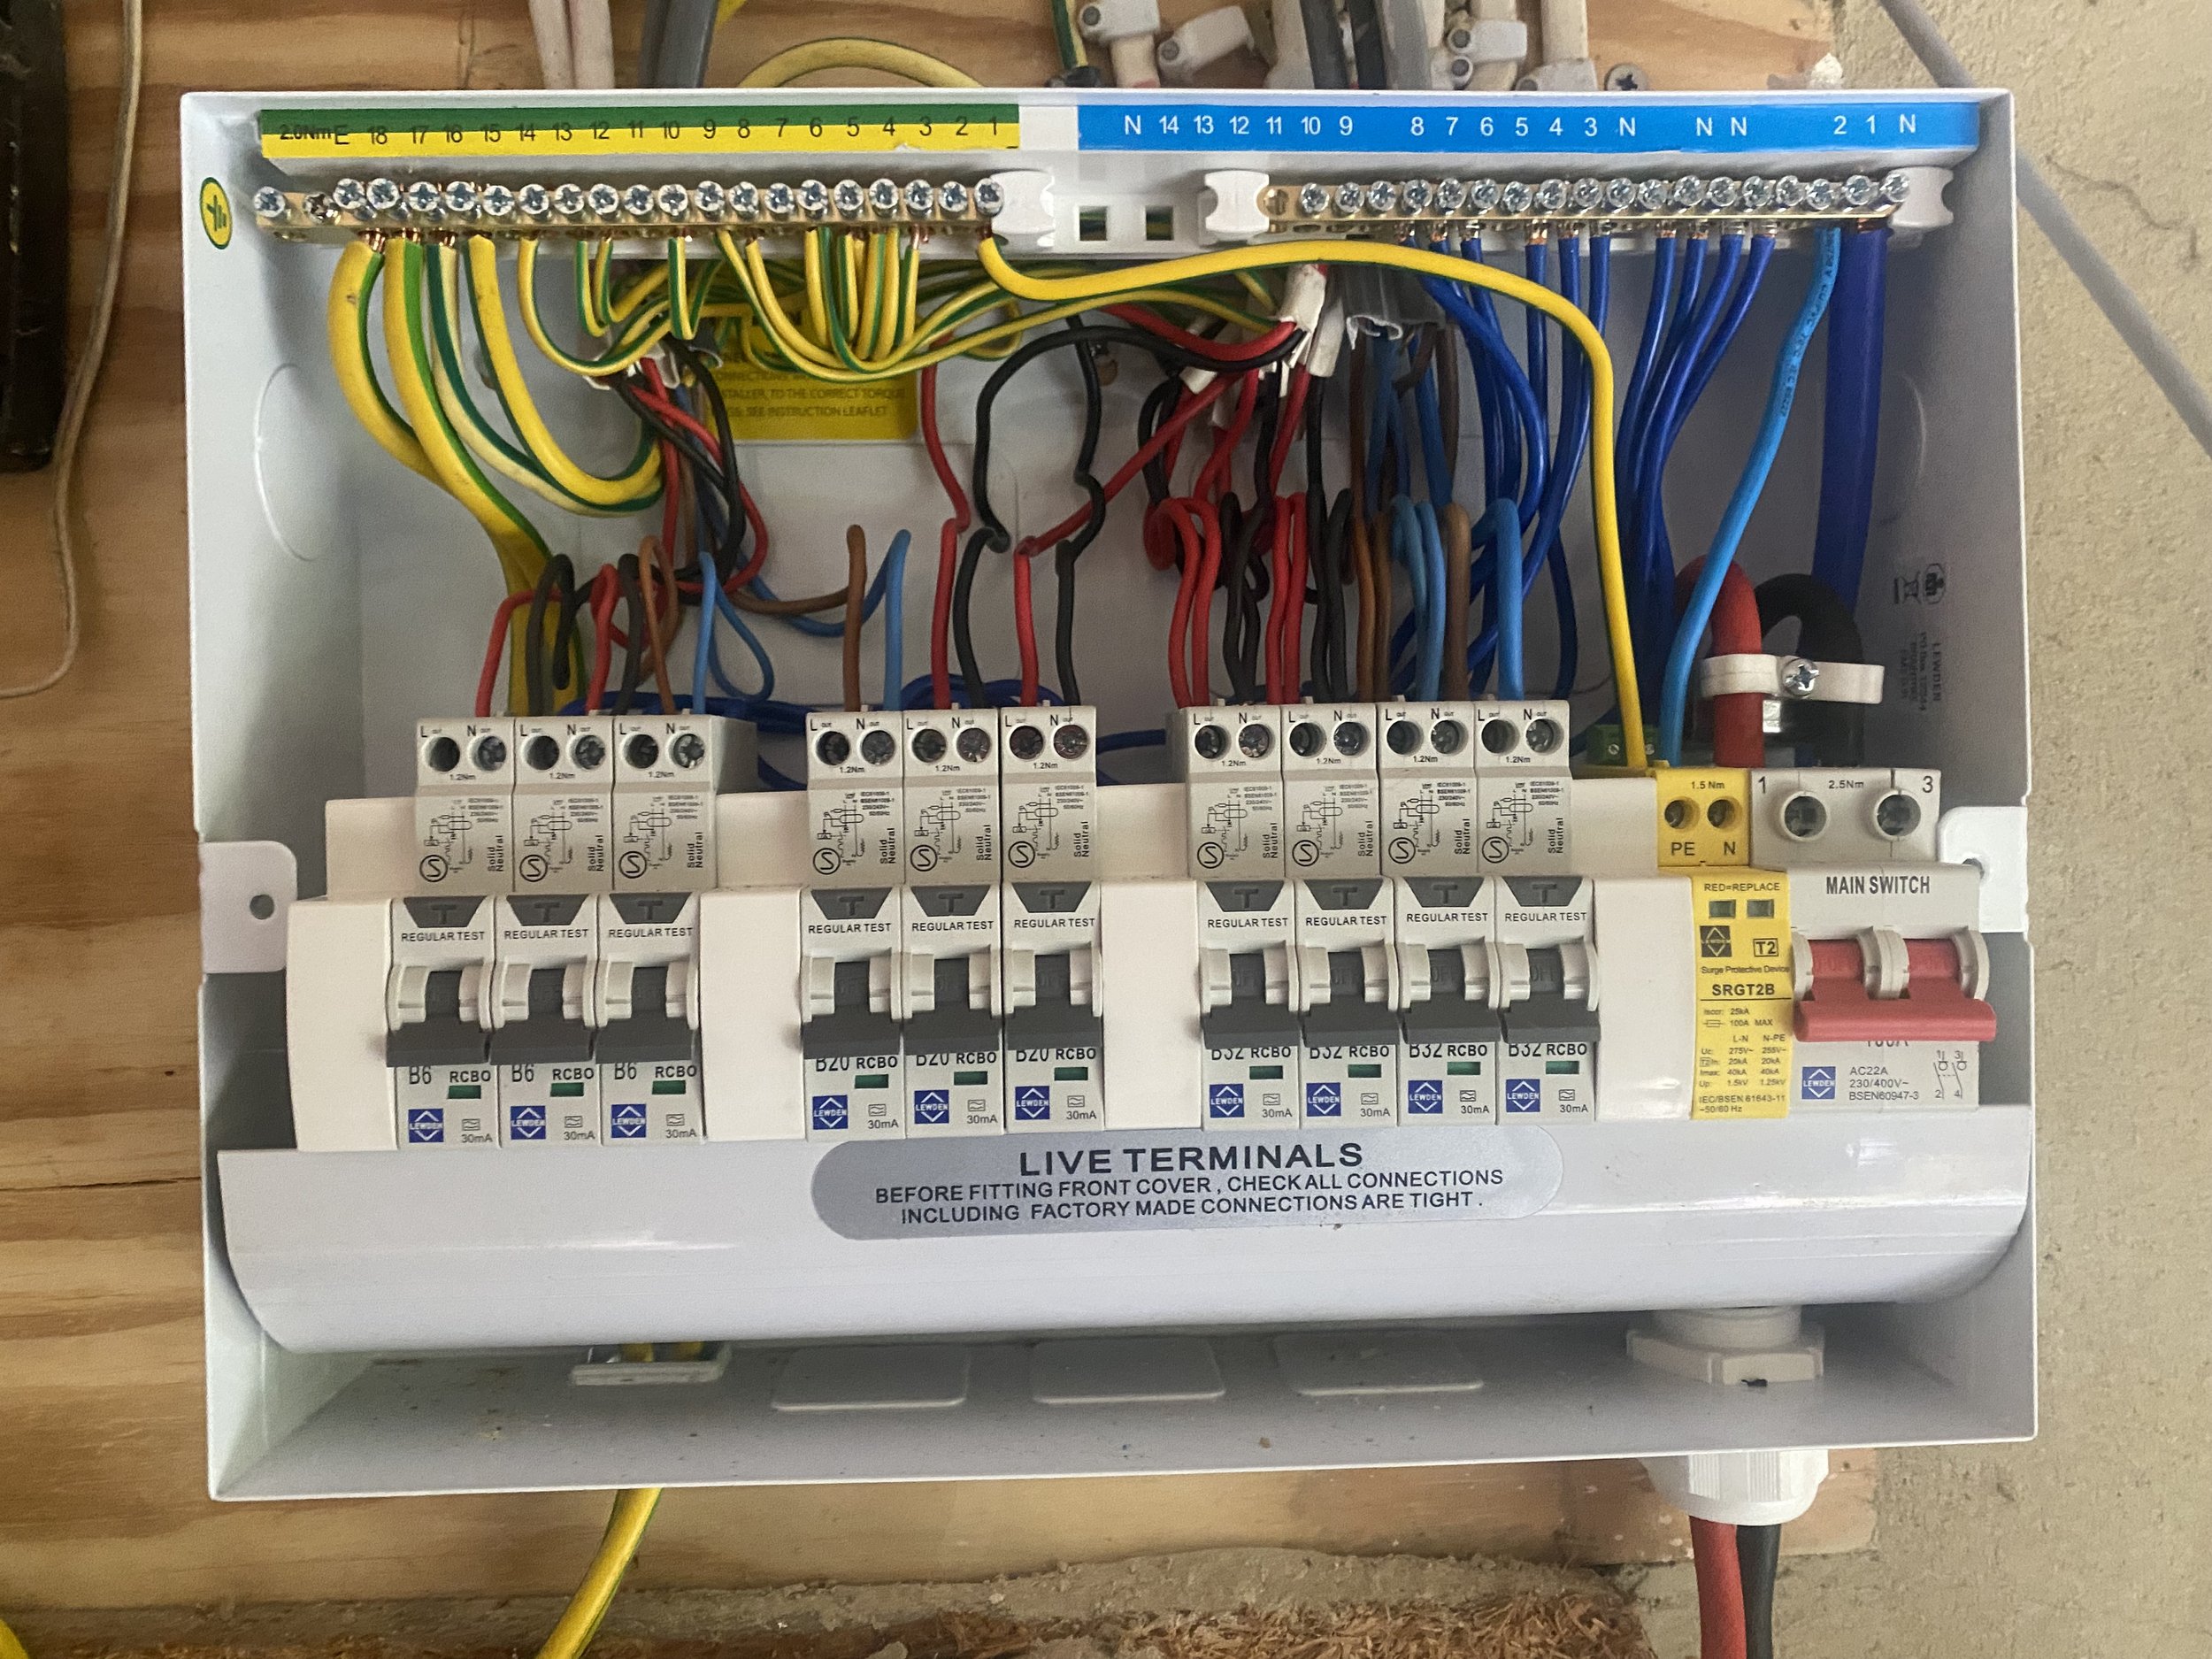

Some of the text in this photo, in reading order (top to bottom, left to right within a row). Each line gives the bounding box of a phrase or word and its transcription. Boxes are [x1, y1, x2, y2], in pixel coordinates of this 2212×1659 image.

[334, 126, 350, 144] E
[369, 126, 388, 145] 18
[411, 126, 427, 144] 17
[446, 126, 463, 143] 16
[484, 125, 501, 142] 15
[519, 124, 536, 142] 14
[555, 124, 572, 142] 13
[592, 122, 611, 140] 12
[629, 120, 643, 138] 11
[663, 121, 680, 140] 10
[703, 120, 716, 140] 9
[738, 120, 750, 139] 8
[775, 119, 787, 136] 7
[810, 119, 823, 137] 6
[848, 119, 859, 136] 5
[882, 118, 895, 135] 4
[919, 118, 932, 136] 3
[956, 118, 968, 135] 2
[990, 117, 996, 135] 1
[1125, 114, 1916, 137] N 14 13 12 11 10 9 8 7 6 5 4 3 N N N 2 1 N
[1386, 709, 1392, 720] L
[1431, 708, 1440, 719] N
[810, 720, 818, 731] L
[856, 718, 865, 729] N
[1692, 780, 1724, 789] 1.5 Nm
[1758, 777, 1766, 794] 1
[1829, 780, 1864, 789] 2.5Nm
[1923, 776, 1933, 793] 3
[1671, 842, 1695, 856] PE
[1724, 841, 1736, 856] N
[1704, 882, 1780, 892] RED=REPLACE
[1826, 876, 1930, 894] MAIN SWITCH
[1306, 915, 1387, 926] REGULAR TEST
[1406, 912, 1487, 923] REGULAR TEST
[1505, 911, 1587, 922] REGULAR TEST
[911, 921, 994, 932] REGULAR TEST
[1014, 918, 1095, 928] REGULAR TEST
[1208, 917, 1287, 928] REGULAR TEST
[609, 927, 693, 938] REGULAR TEST
[808, 923, 891, 934] REGULAR TEST
[401, 932, 485, 942] REGULAR TEST
[504, 929, 588, 940] REGULAR TEST
[1755, 940, 1776, 954] T2
[1712, 984, 1775, 996] SRGT2B
[1056, 1048, 1096, 1060] RCBO
[1250, 1046, 1291, 1057] RCBO
[1348, 1045, 1389, 1057] RCBO
[1448, 1044, 1487, 1056] RCBO
[1546, 1043, 1587, 1055] RCBO
[856, 1056, 898, 1069] RCBO
[956, 1052, 997, 1064] RCBO
[449, 1071, 491, 1082] RCBO
[552, 1068, 595, 1079] RCBO
[655, 1065, 697, 1078] RCBO
[1849, 1079, 1909, 1088] 230/400V~
[1849, 1091, 1919, 1101] BSEN60947-3
[814, 1108, 847, 1117] LEWDEN
[1262, 1108, 1292, 1118] 30mA
[1360, 1107, 1390, 1117] 30mA
[1461, 1104, 1489, 1114] 30mA
[1559, 1103, 1588, 1113] 30mA
[967, 1115, 998, 1125] 30mA
[1066, 1110, 1096, 1120] 30mA
[868, 1119, 899, 1129] 30mA
[462, 1133, 493, 1144] 30mA
[564, 1131, 595, 1141] 30mA
[665, 1129, 697, 1139] 30mA
[1020, 1143, 1363, 1176] LIVE TERMINALS
[876, 1185, 963, 1203] BEFORE
[969, 1181, 1053, 1200] FITTING
[1059, 1179, 1131, 1197] FRONT
[1227, 1174, 1302, 1192] CHECK
[1305, 1173, 1342, 1190] ALL
[1348, 1170, 1503, 1189] CONNECTIONS
[902, 1205, 1019, 1224] INCLUDING
[1031, 1202, 1130, 1219] FACTORY
[1136, 1199, 1195, 1217] MADE
[1202, 1194, 1357, 1214] CONNECTIONS
[1362, 1194, 1404, 1210] ARE
